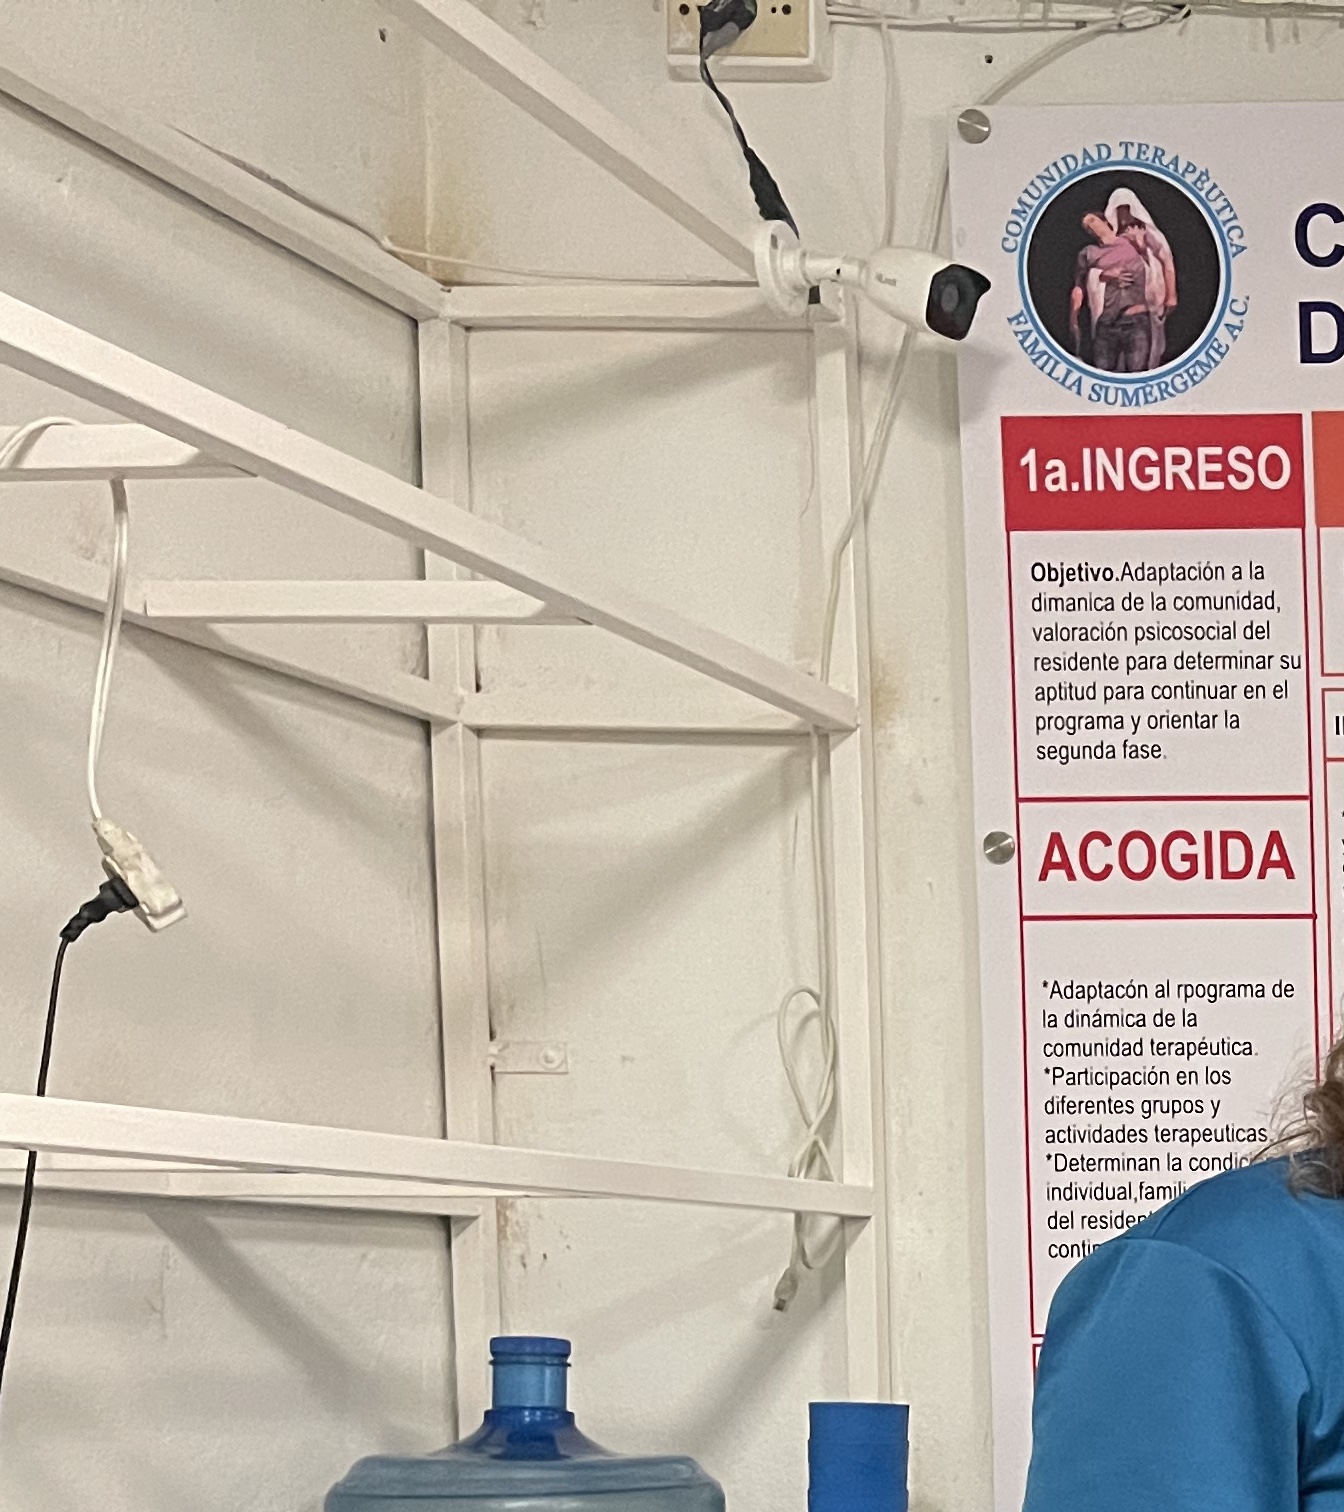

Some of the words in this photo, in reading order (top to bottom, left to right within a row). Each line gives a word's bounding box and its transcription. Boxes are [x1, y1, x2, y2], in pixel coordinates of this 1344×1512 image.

[1001, 143, 1112, 254] COMUNIDAD
[1007, 309, 1083, 397] FAMILIA
[1020, 445, 1290, 492] 1a.INGRESO
[1232, 566, 1242, 580] a
[1250, 561, 1264, 580] la
[1122, 592, 1144, 611] de
[1151, 592, 1166, 611] la
[1174, 590, 1280, 613] comunidad,
[1032, 621, 1127, 641] valoración
[1135, 620, 1236, 645] psicosocial
[1243, 620, 1270, 640] del
[1034, 652, 1119, 671] residente
[1127, 656, 1166, 675] para
[1174, 650, 1274, 670] determinar
[1280, 655, 1301, 669] su
[1035, 681, 1096, 705] aptitud
[1104, 686, 1144, 704] para
[1151, 680, 1237, 699] continuar
[1244, 685, 1265, 699] en
[1273, 680, 1287, 699] el
[1036, 715, 1124, 735] programa
[1131, 715, 1141, 735] y
[1148, 710, 1218, 729] orientar
[1225, 710, 1239, 729] la
[1037, 740, 1115, 765] segunda
[1038, 830, 1295, 881] ACOGIDA
[1155, 979, 1169, 998] al
[1178, 984, 1265, 1003] rpograma
[1272, 980, 1294, 998] de
[1043, 1010, 1057, 1028] la
[1065, 1009, 1146, 1028] dinámica
[1153, 1008, 1175, 1027] de
[1183, 1008, 1197, 1027] la
[1044, 1038, 1143, 1057] comunidad
[1177, 1071, 1198, 1085] en
[1206, 1066, 1231, 1084] los
[1045, 1095, 1134, 1114] diferentes
[1141, 1100, 1204, 1119] grupos
[1211, 1100, 1220, 1119] y
